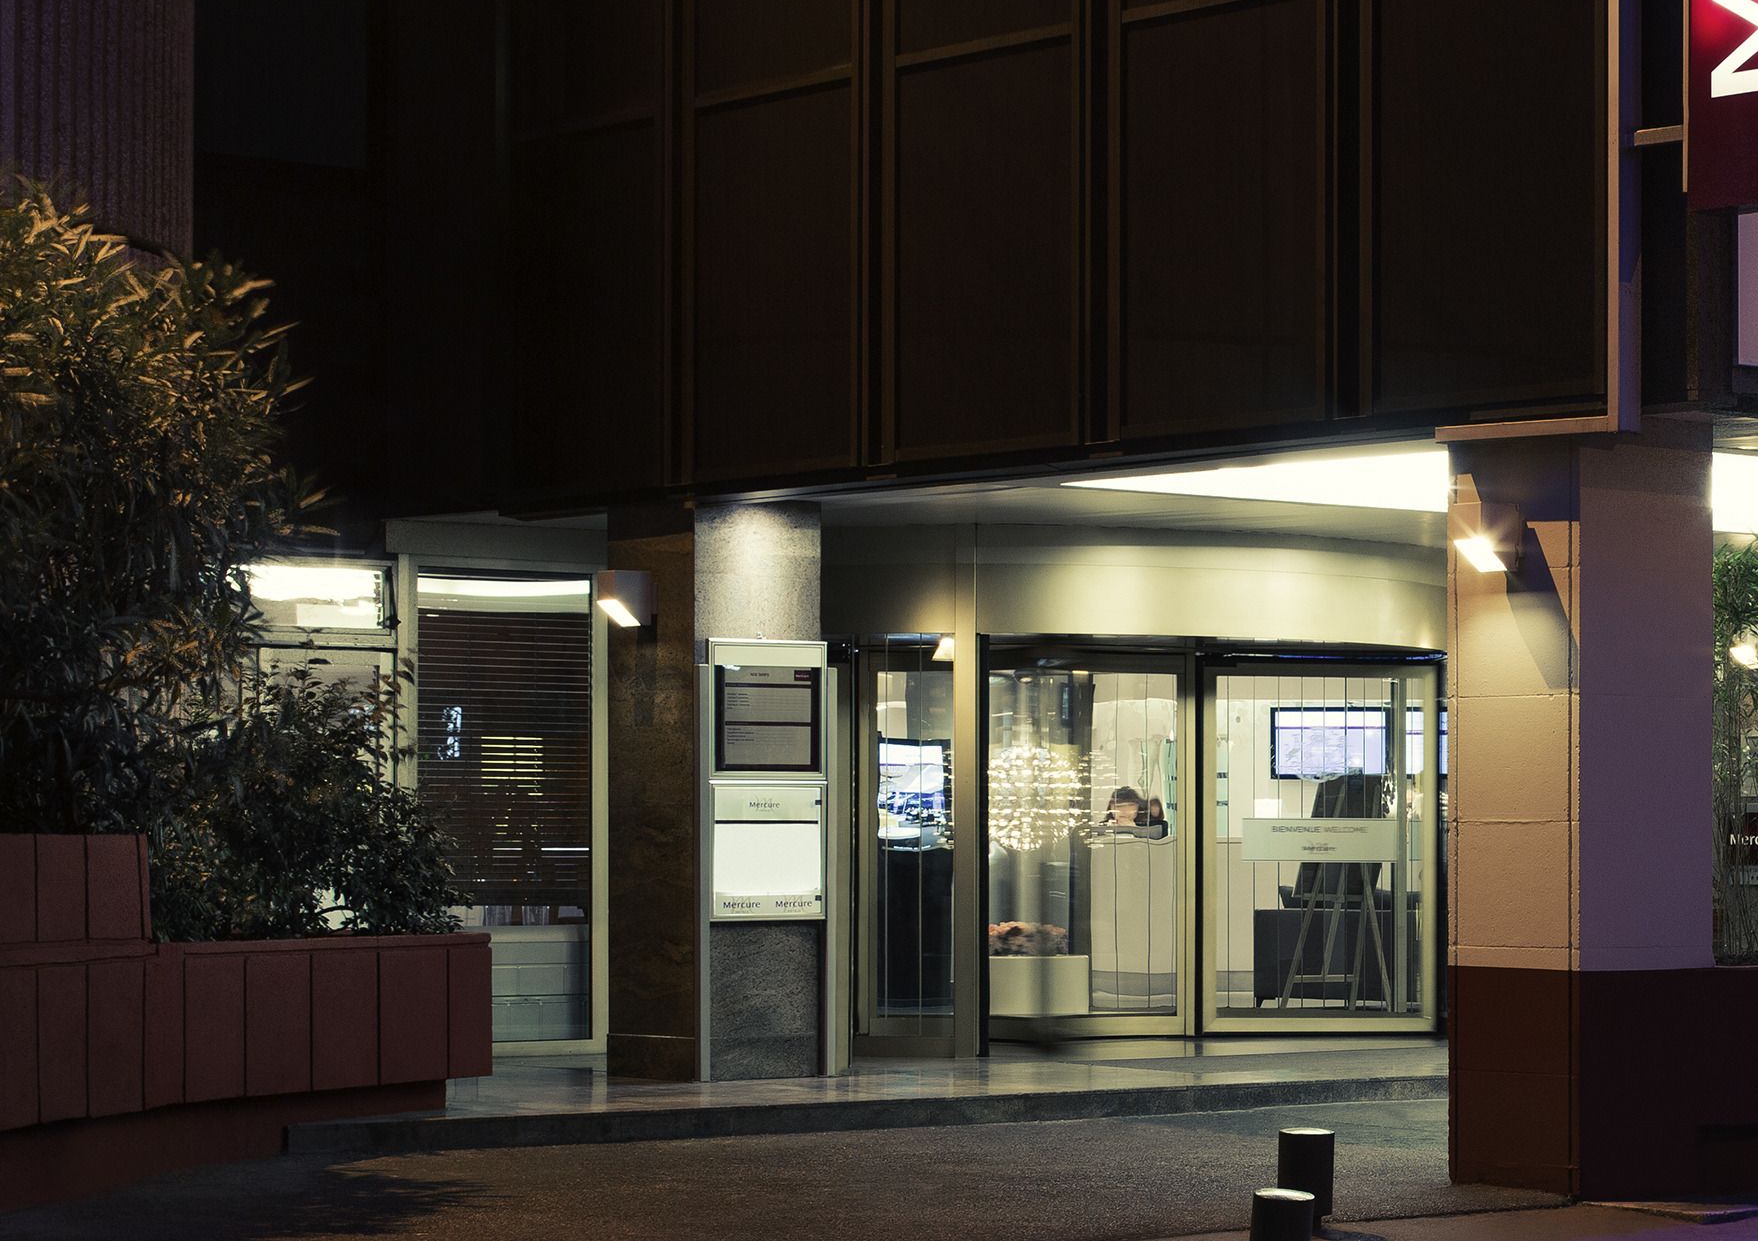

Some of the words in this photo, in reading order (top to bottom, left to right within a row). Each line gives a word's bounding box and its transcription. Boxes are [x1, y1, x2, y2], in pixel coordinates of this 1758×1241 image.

[749, 801, 781, 809] Mercure
[723, 901, 761, 909] Mercure
[775, 899, 813, 908] Mercure
